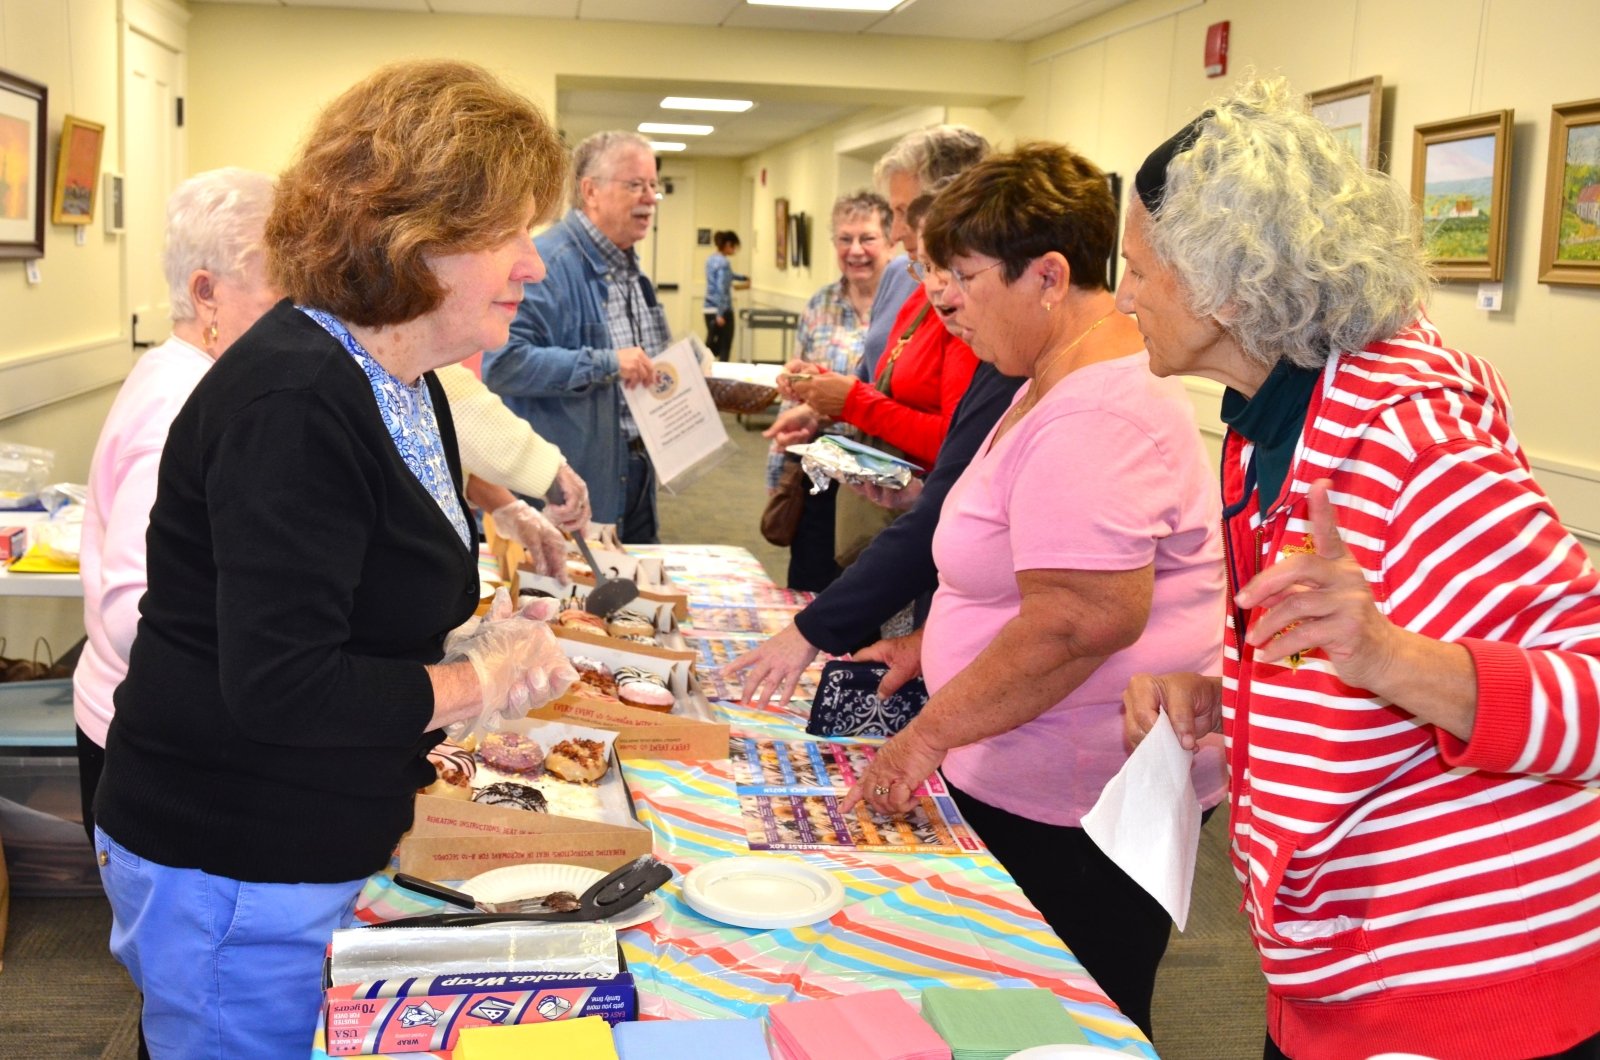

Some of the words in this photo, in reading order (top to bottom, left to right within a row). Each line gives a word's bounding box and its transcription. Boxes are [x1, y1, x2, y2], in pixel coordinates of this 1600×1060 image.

[441, 976, 508, 987] Wrap
[510, 972, 616, 984] Reynolds
[334, 1004, 360, 1013] years
[361, 1003, 376, 1014] 70
[601, 1002, 612, 1010] you
[334, 1029, 358, 1038] USA
